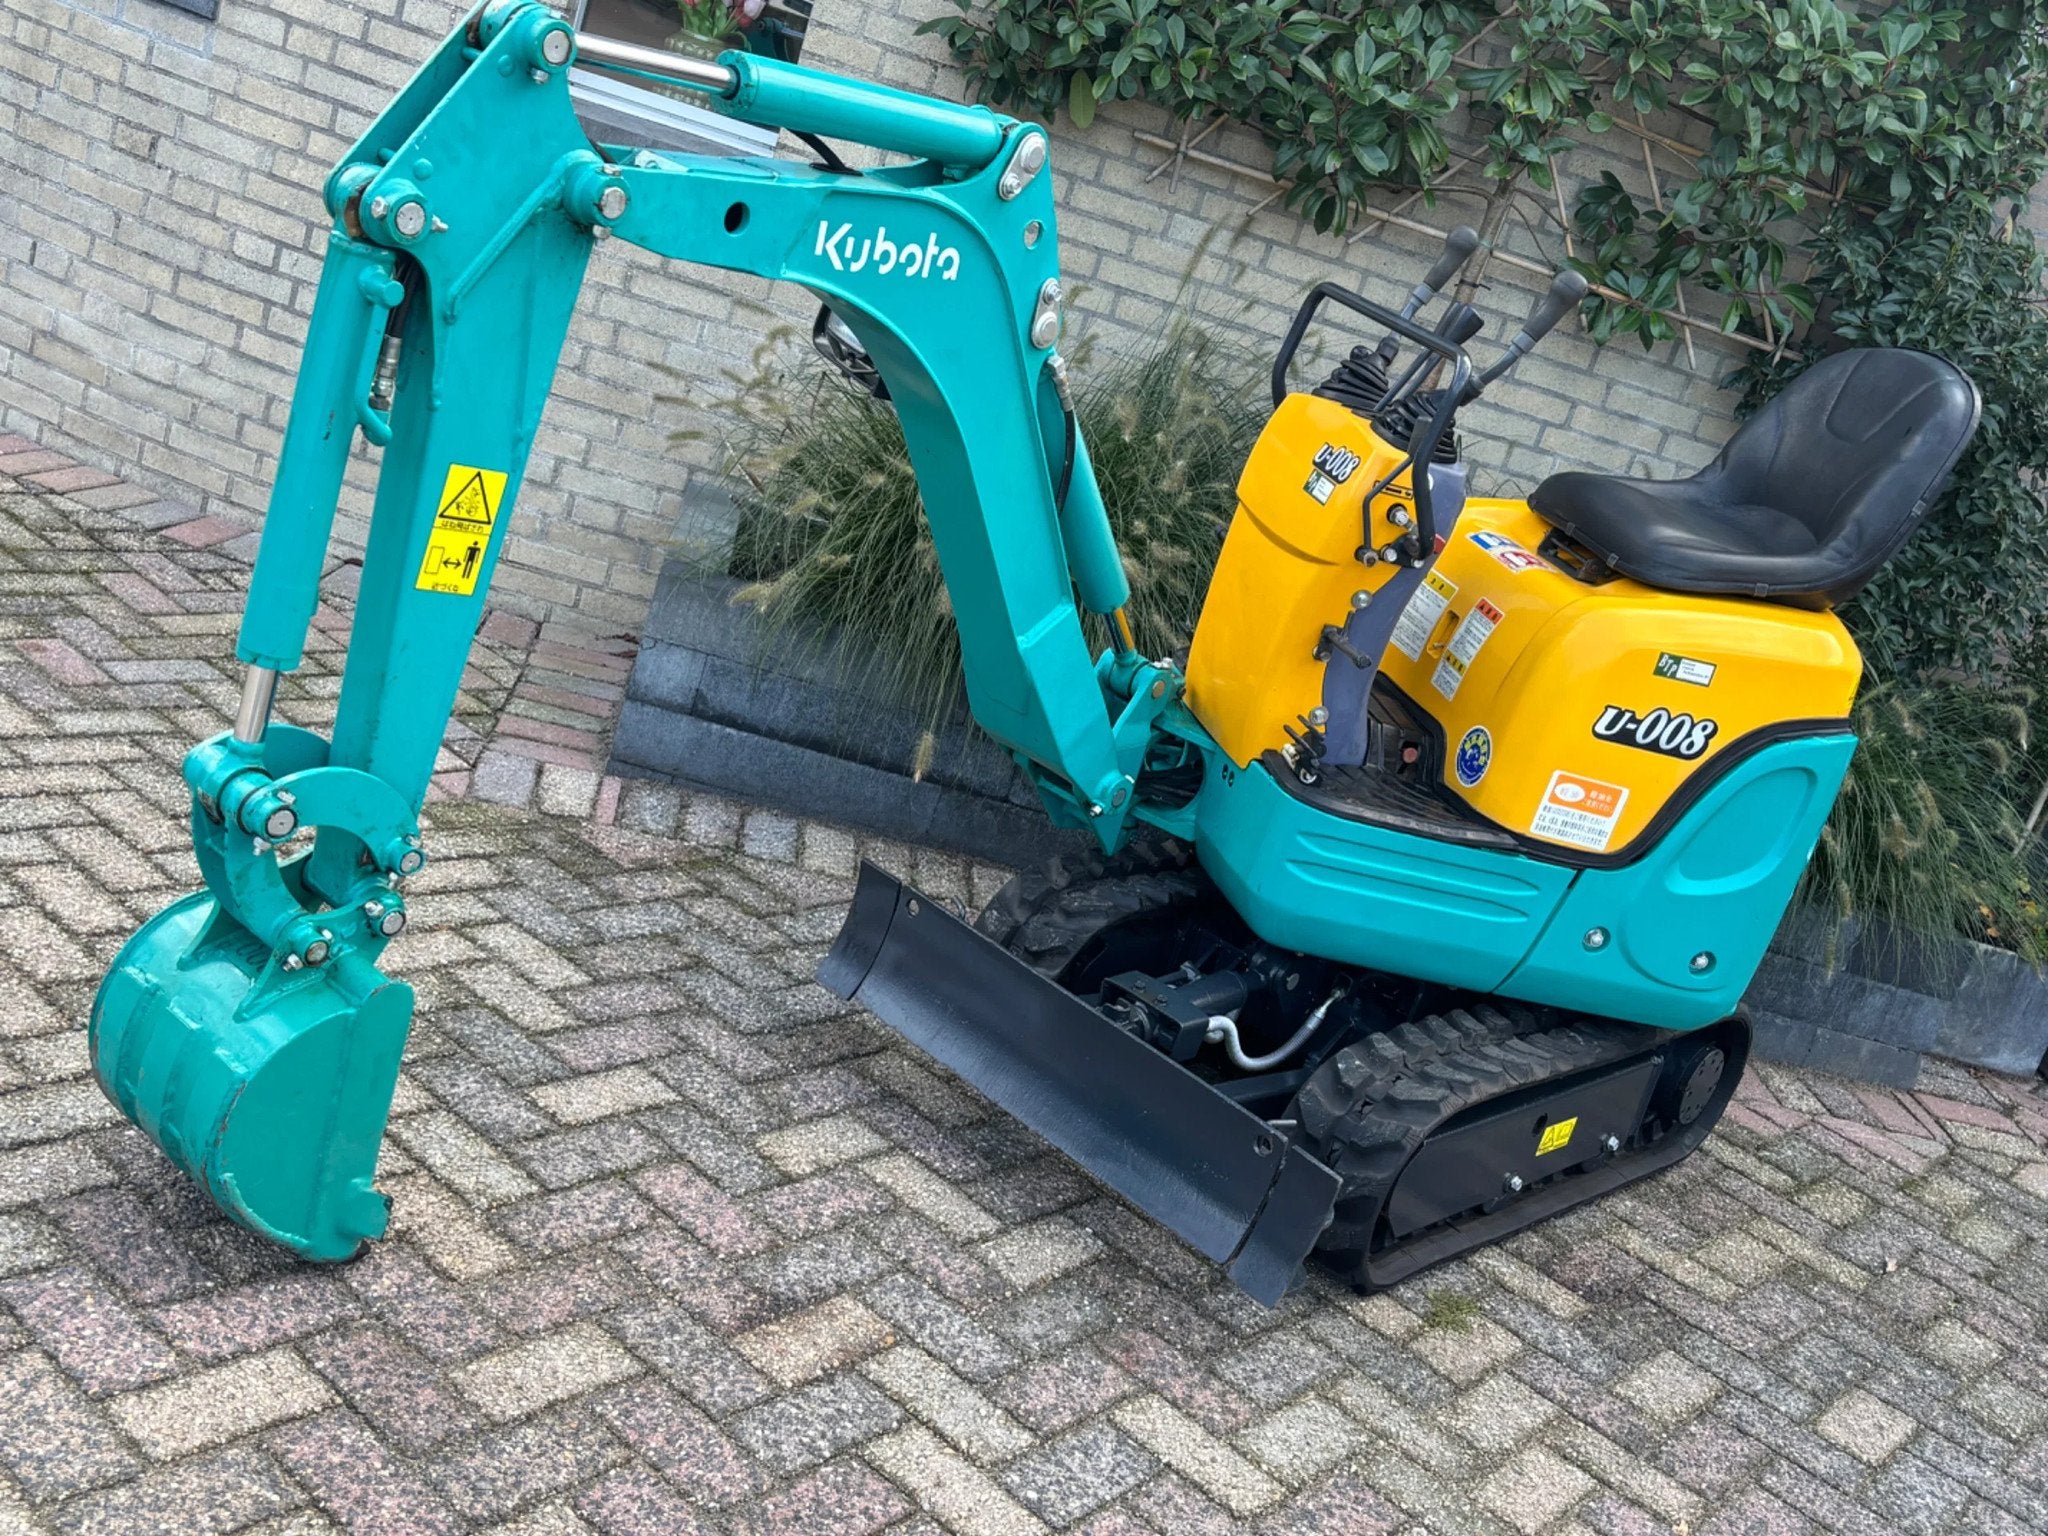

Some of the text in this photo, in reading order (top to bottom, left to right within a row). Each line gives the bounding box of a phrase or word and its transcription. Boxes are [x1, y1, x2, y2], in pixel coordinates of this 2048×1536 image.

[814, 219, 961, 281] Kubota
[1313, 443, 1360, 481] U-008
[1593, 706, 1716, 755] U-008
